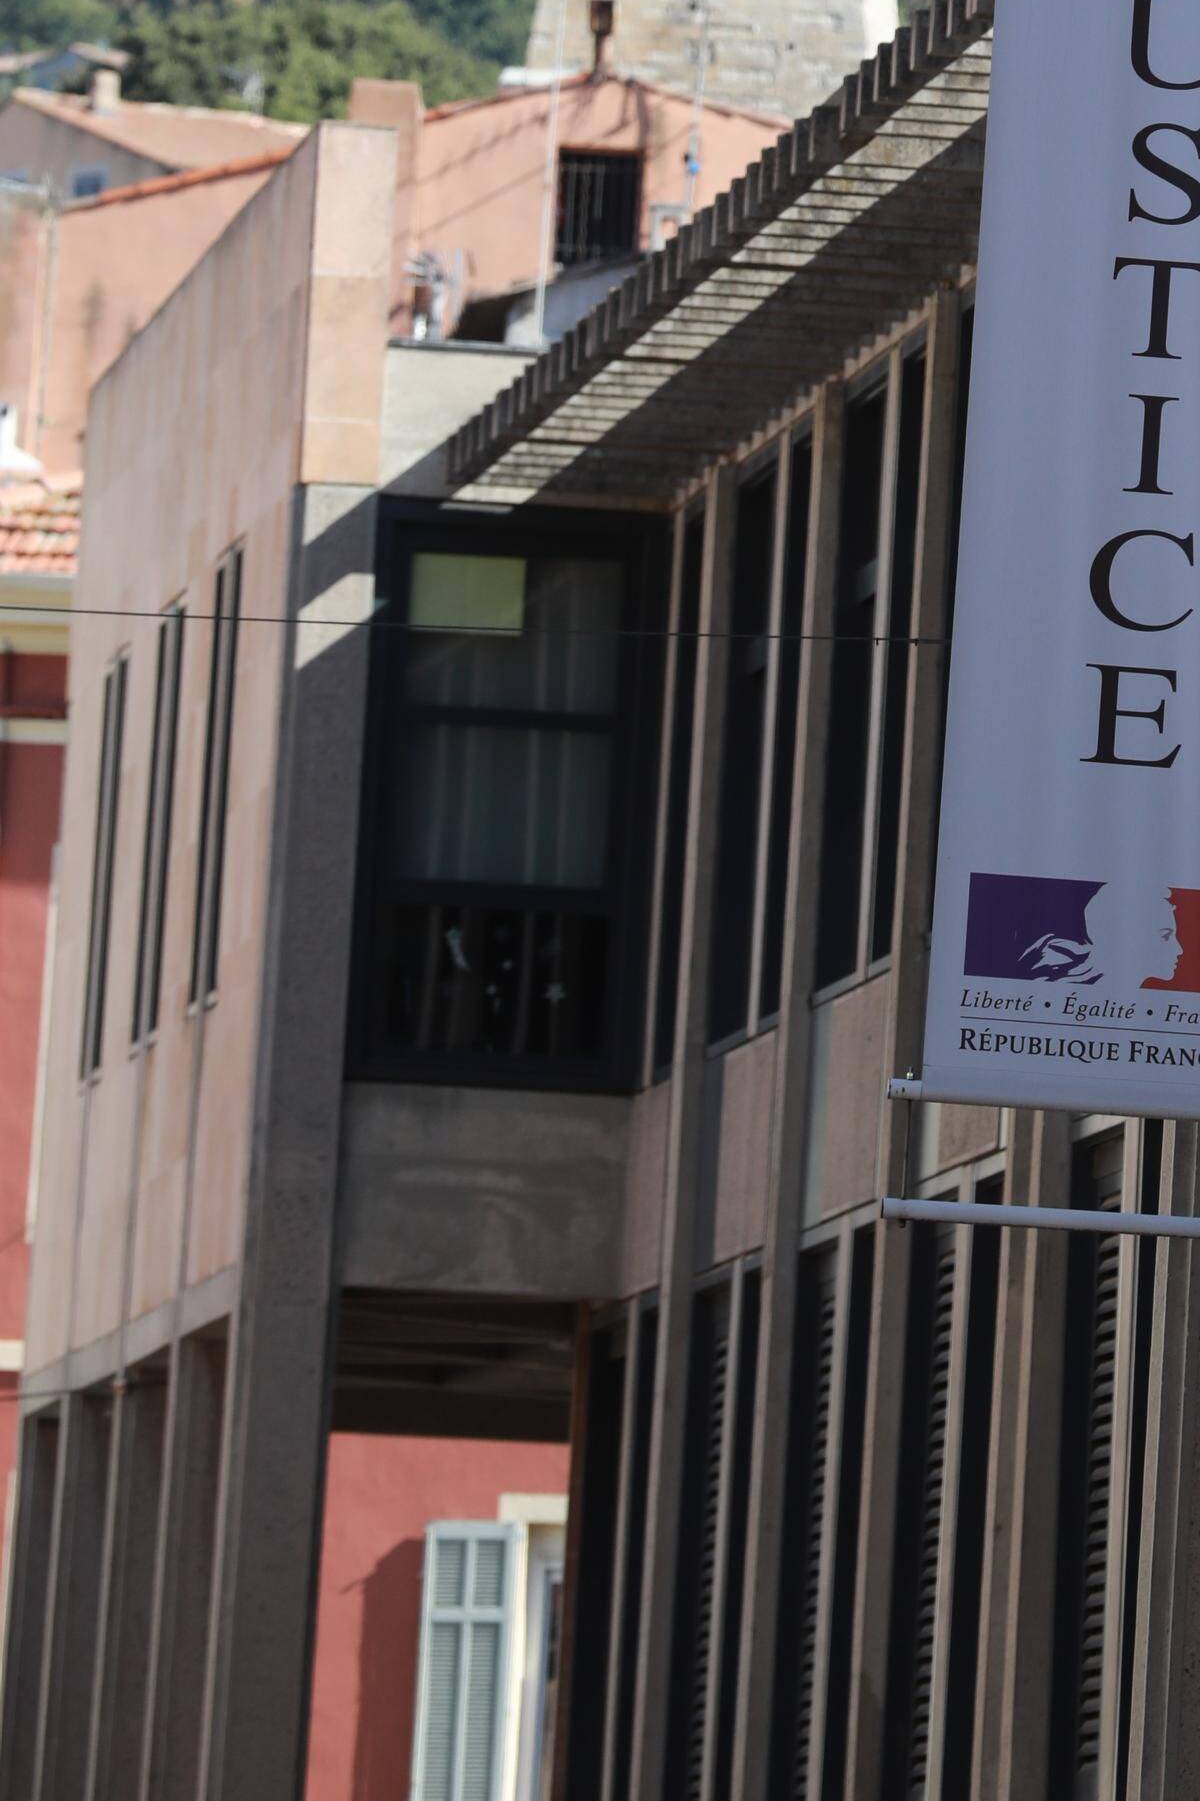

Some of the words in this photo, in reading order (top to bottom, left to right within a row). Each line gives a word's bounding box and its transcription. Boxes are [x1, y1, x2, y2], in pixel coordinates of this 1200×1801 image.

[961, 989, 1032, 1011] Liberté
[1062, 992, 1135, 1022] Égalité
[959, 1028, 1120, 1064] RÉPUBLIQUE
